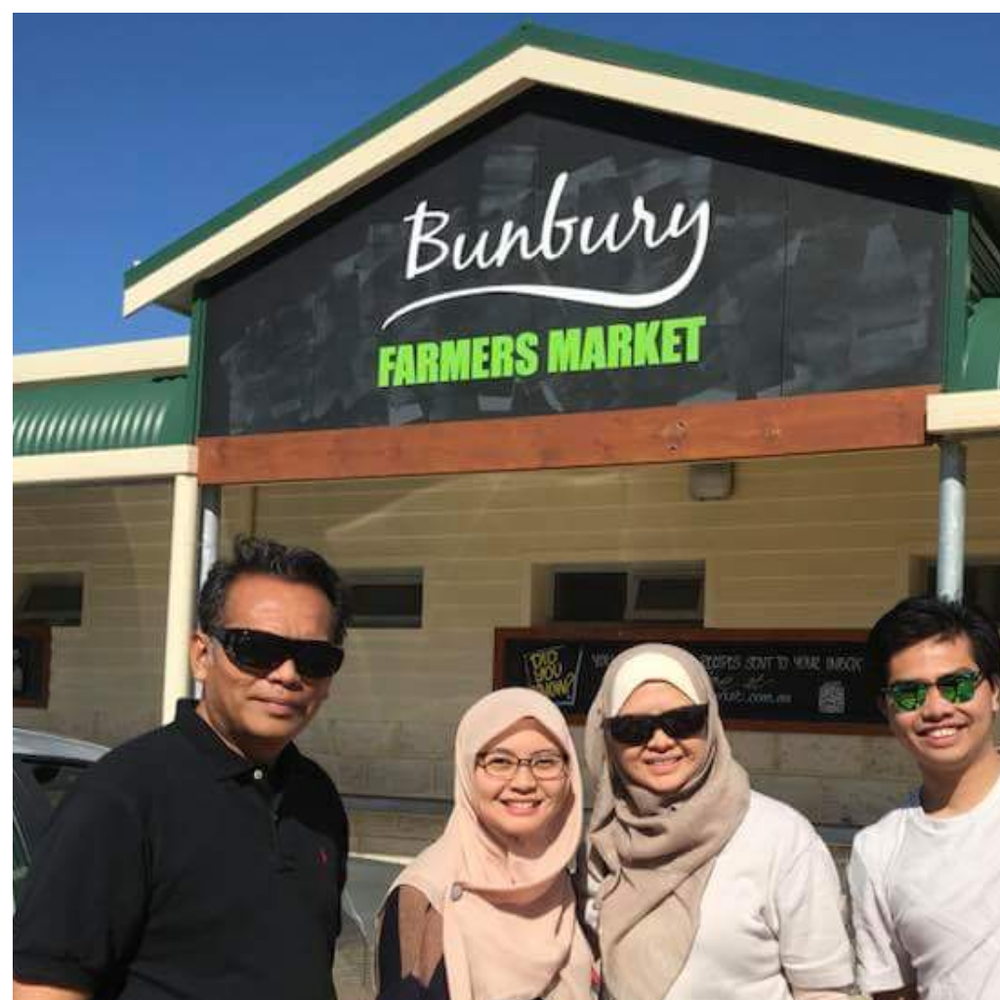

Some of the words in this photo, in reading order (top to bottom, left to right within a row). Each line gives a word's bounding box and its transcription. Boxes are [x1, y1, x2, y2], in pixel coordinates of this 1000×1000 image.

[385, 172, 710, 308] Bunbury
[378, 332, 539, 387] FARMERS
[547, 315, 706, 373] MARKET
